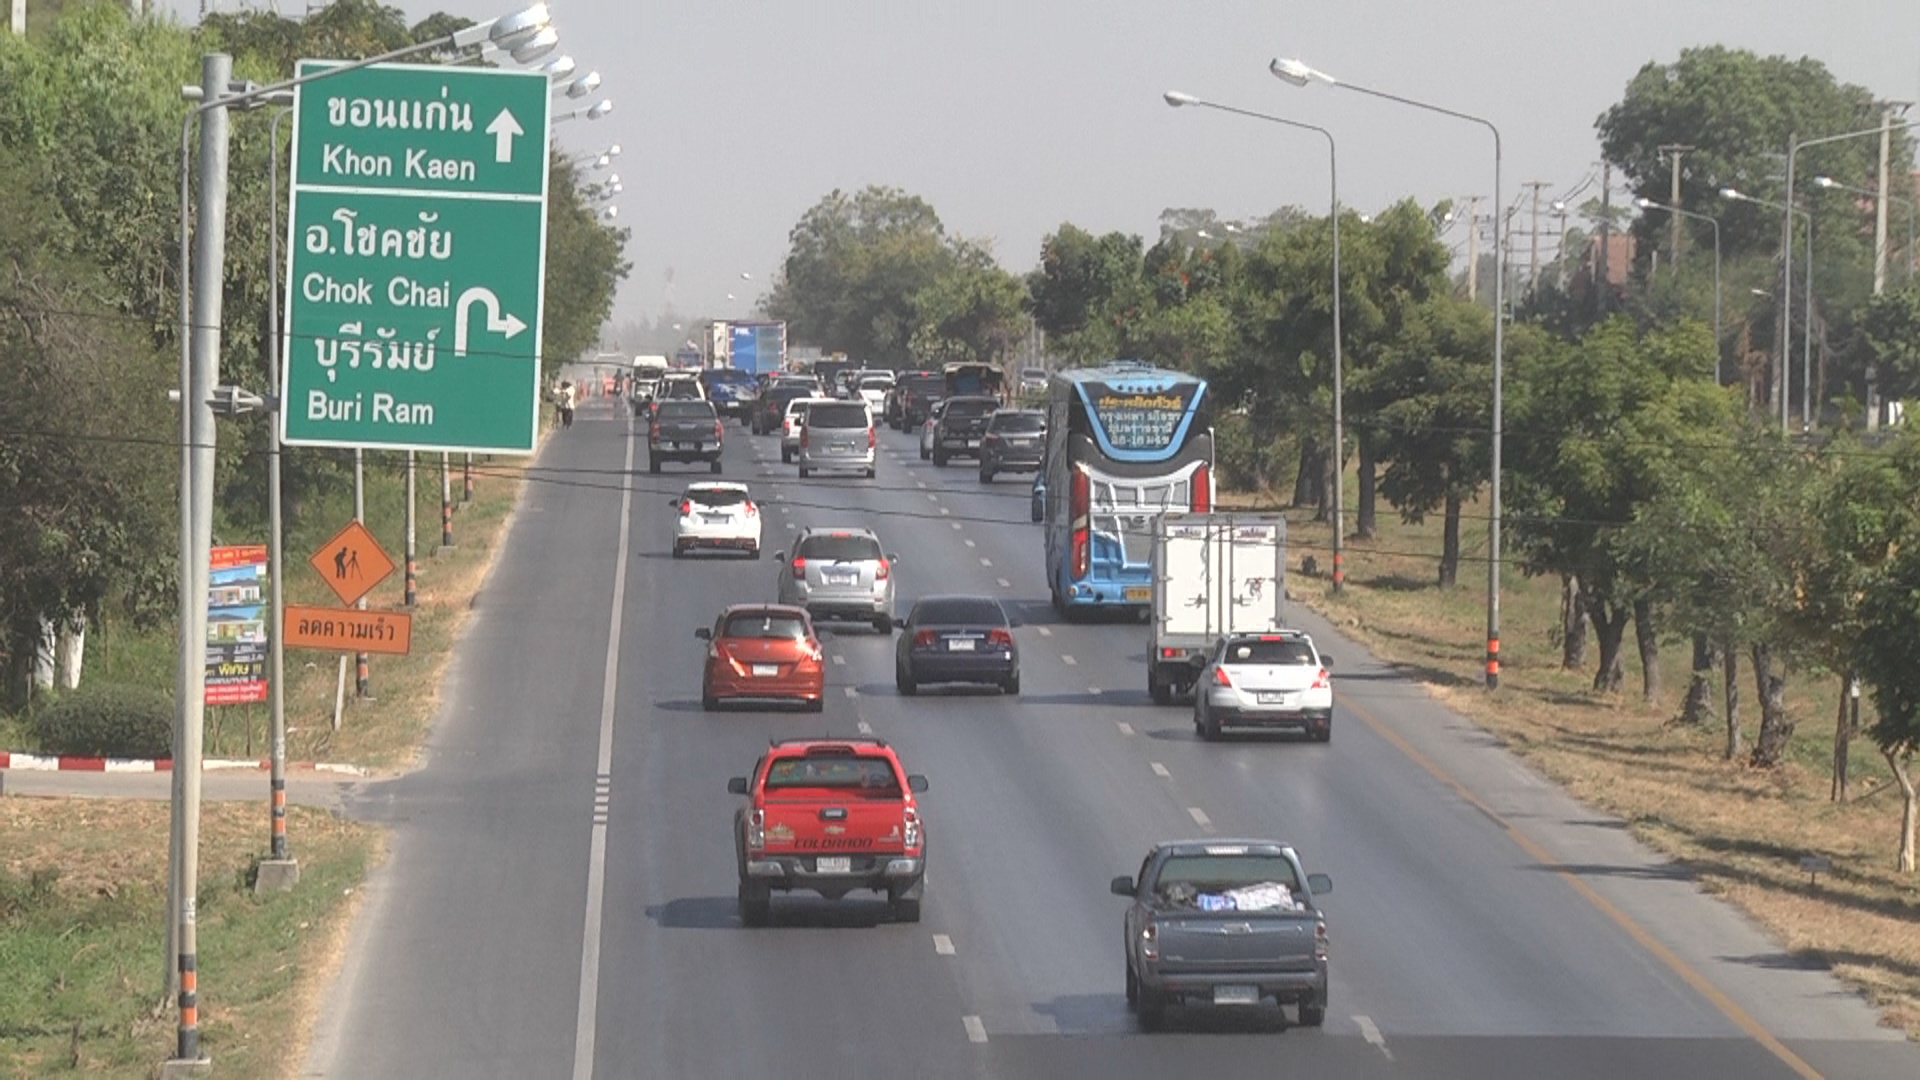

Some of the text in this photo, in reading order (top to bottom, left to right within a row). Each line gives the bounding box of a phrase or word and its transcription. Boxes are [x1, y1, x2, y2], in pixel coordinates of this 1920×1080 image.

[327, 87, 474, 131] ขอนแก่น
[322, 143, 476, 181] Khon Kaen
[305, 207, 453, 260] อ.โชคชัย
[302, 272, 451, 308] Chok Chai
[315, 321, 441, 382] บุรีรัมย์
[307, 390, 435, 425] Buri Ram
[298, 616, 396, 641] ลดความเร็ว
